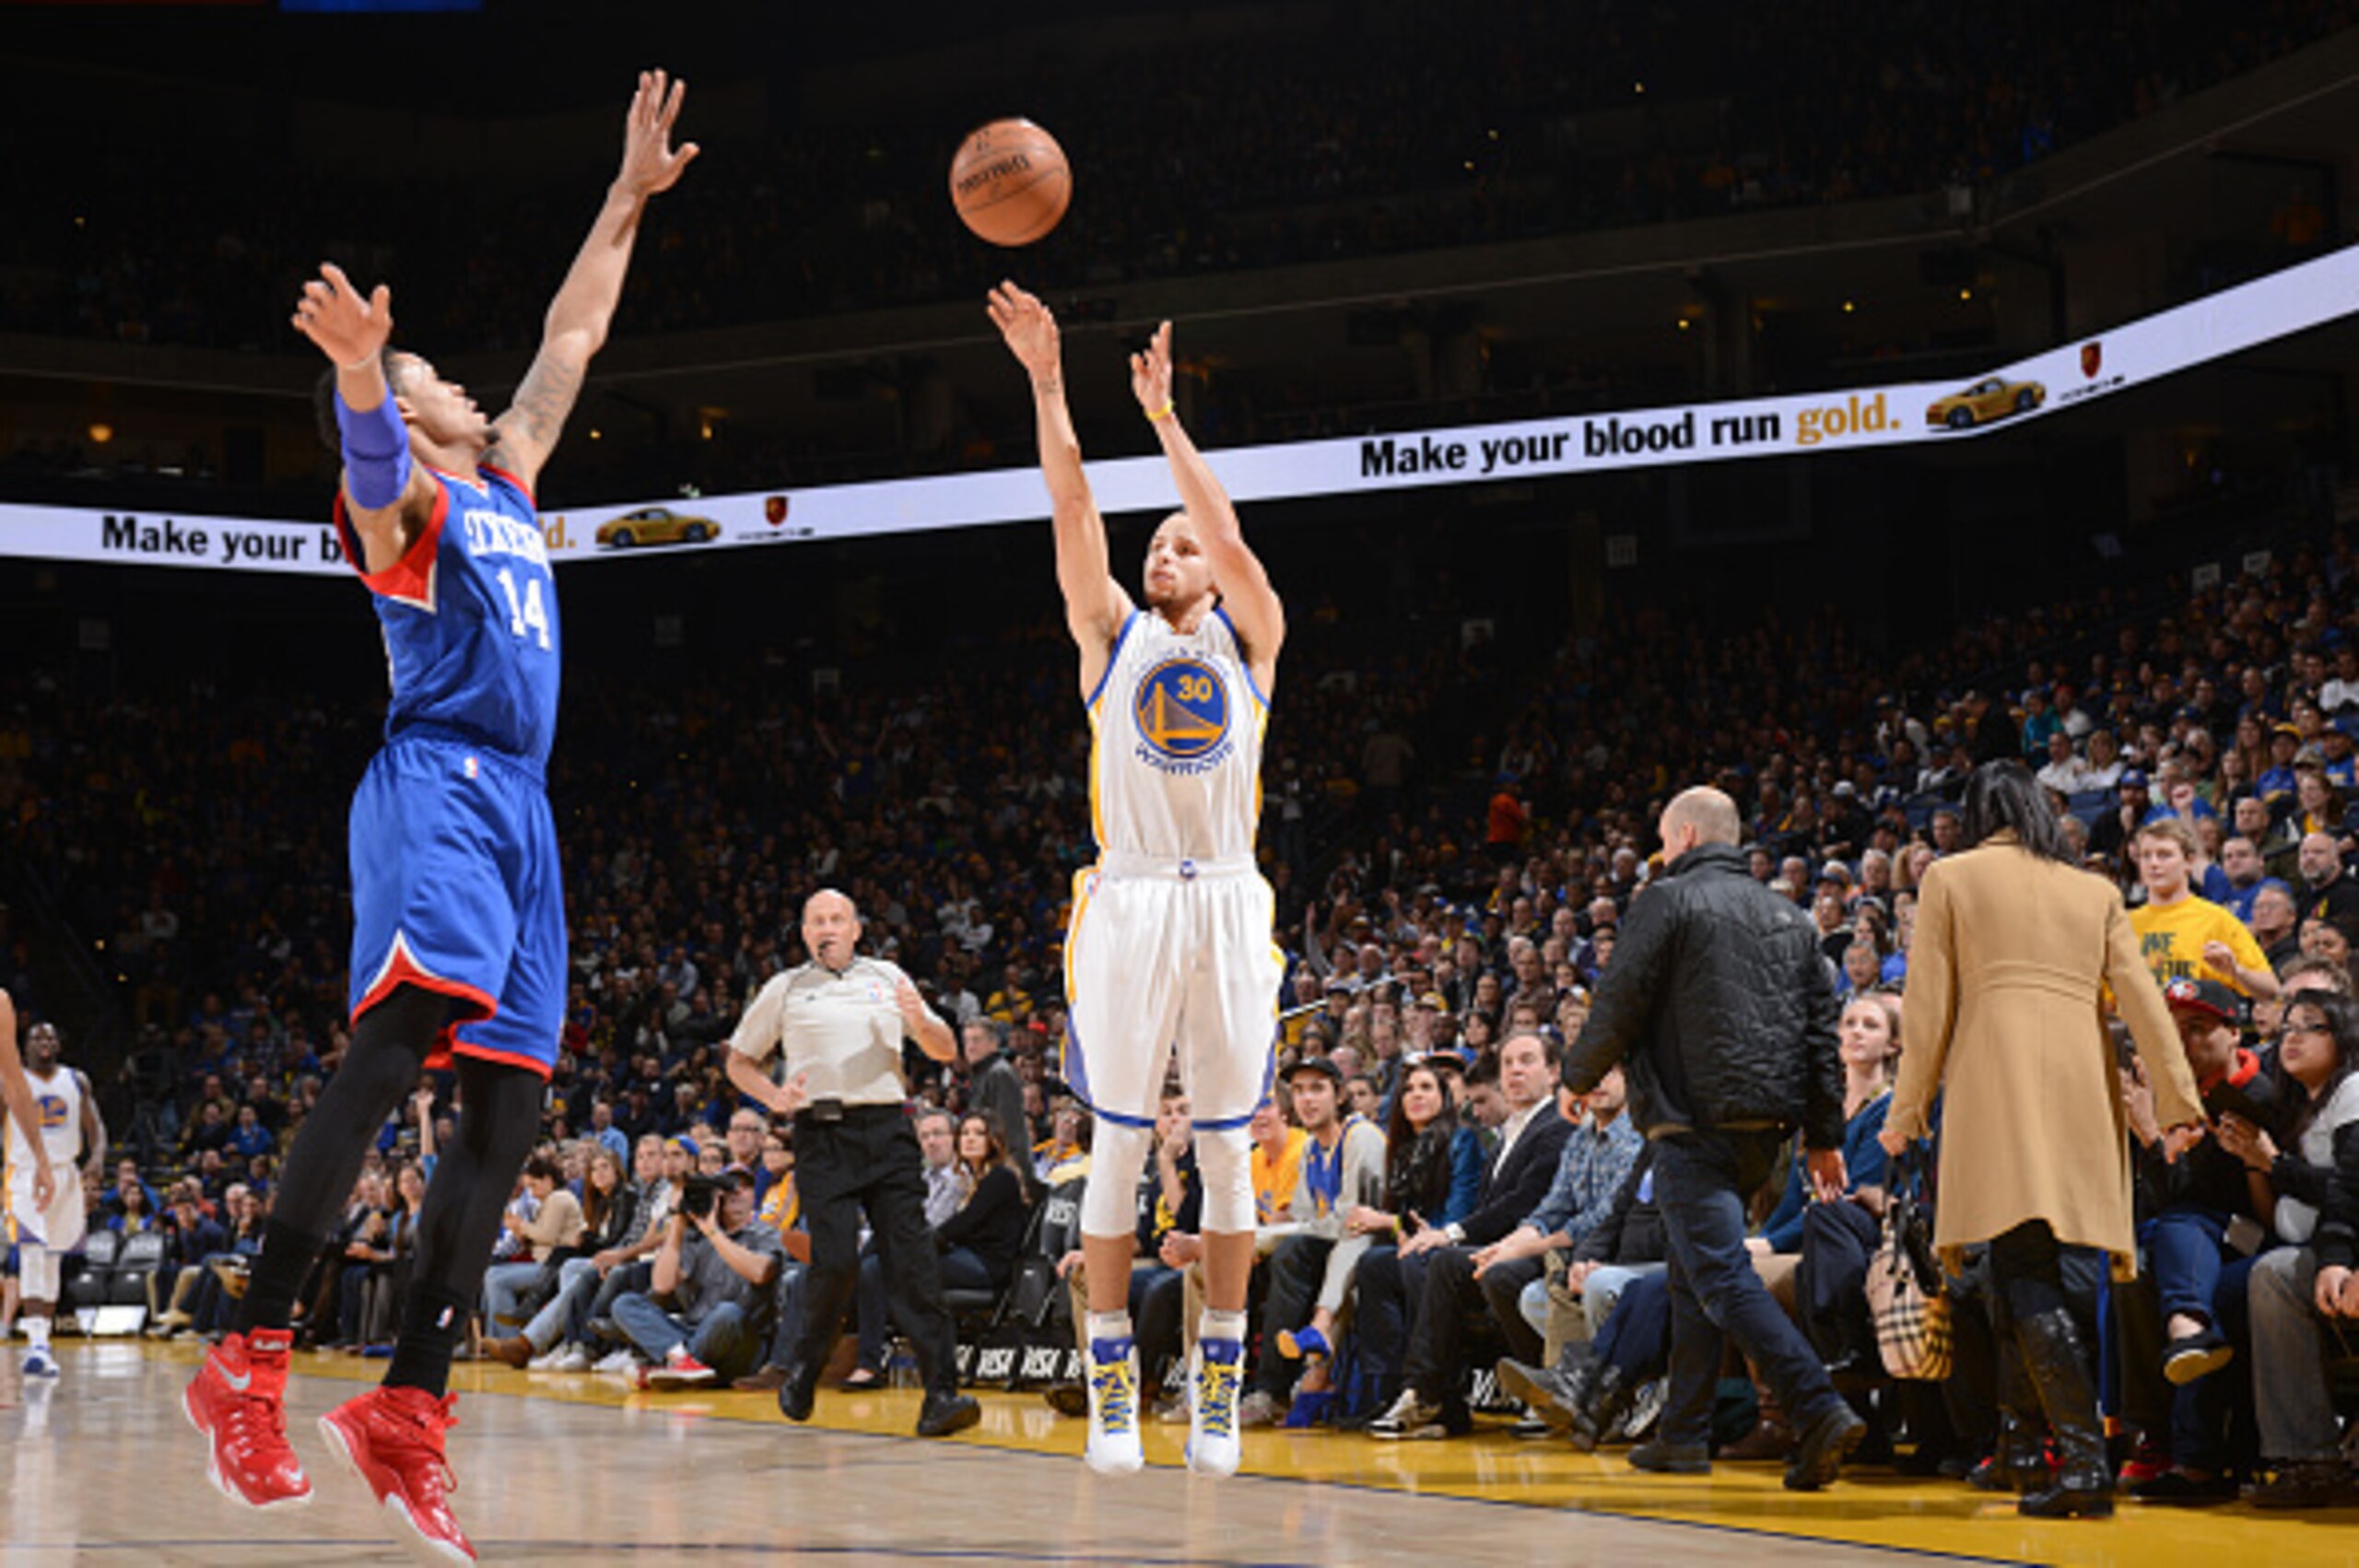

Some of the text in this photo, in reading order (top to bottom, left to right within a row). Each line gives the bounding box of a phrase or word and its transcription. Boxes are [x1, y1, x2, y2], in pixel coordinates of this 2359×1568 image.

[1361, 392, 1901, 477] Make your blood run gold.
[101, 515, 209, 553] Make
[221, 530, 307, 564] your
[496, 568, 552, 652] 14
[1177, 673, 1213, 702] 30
